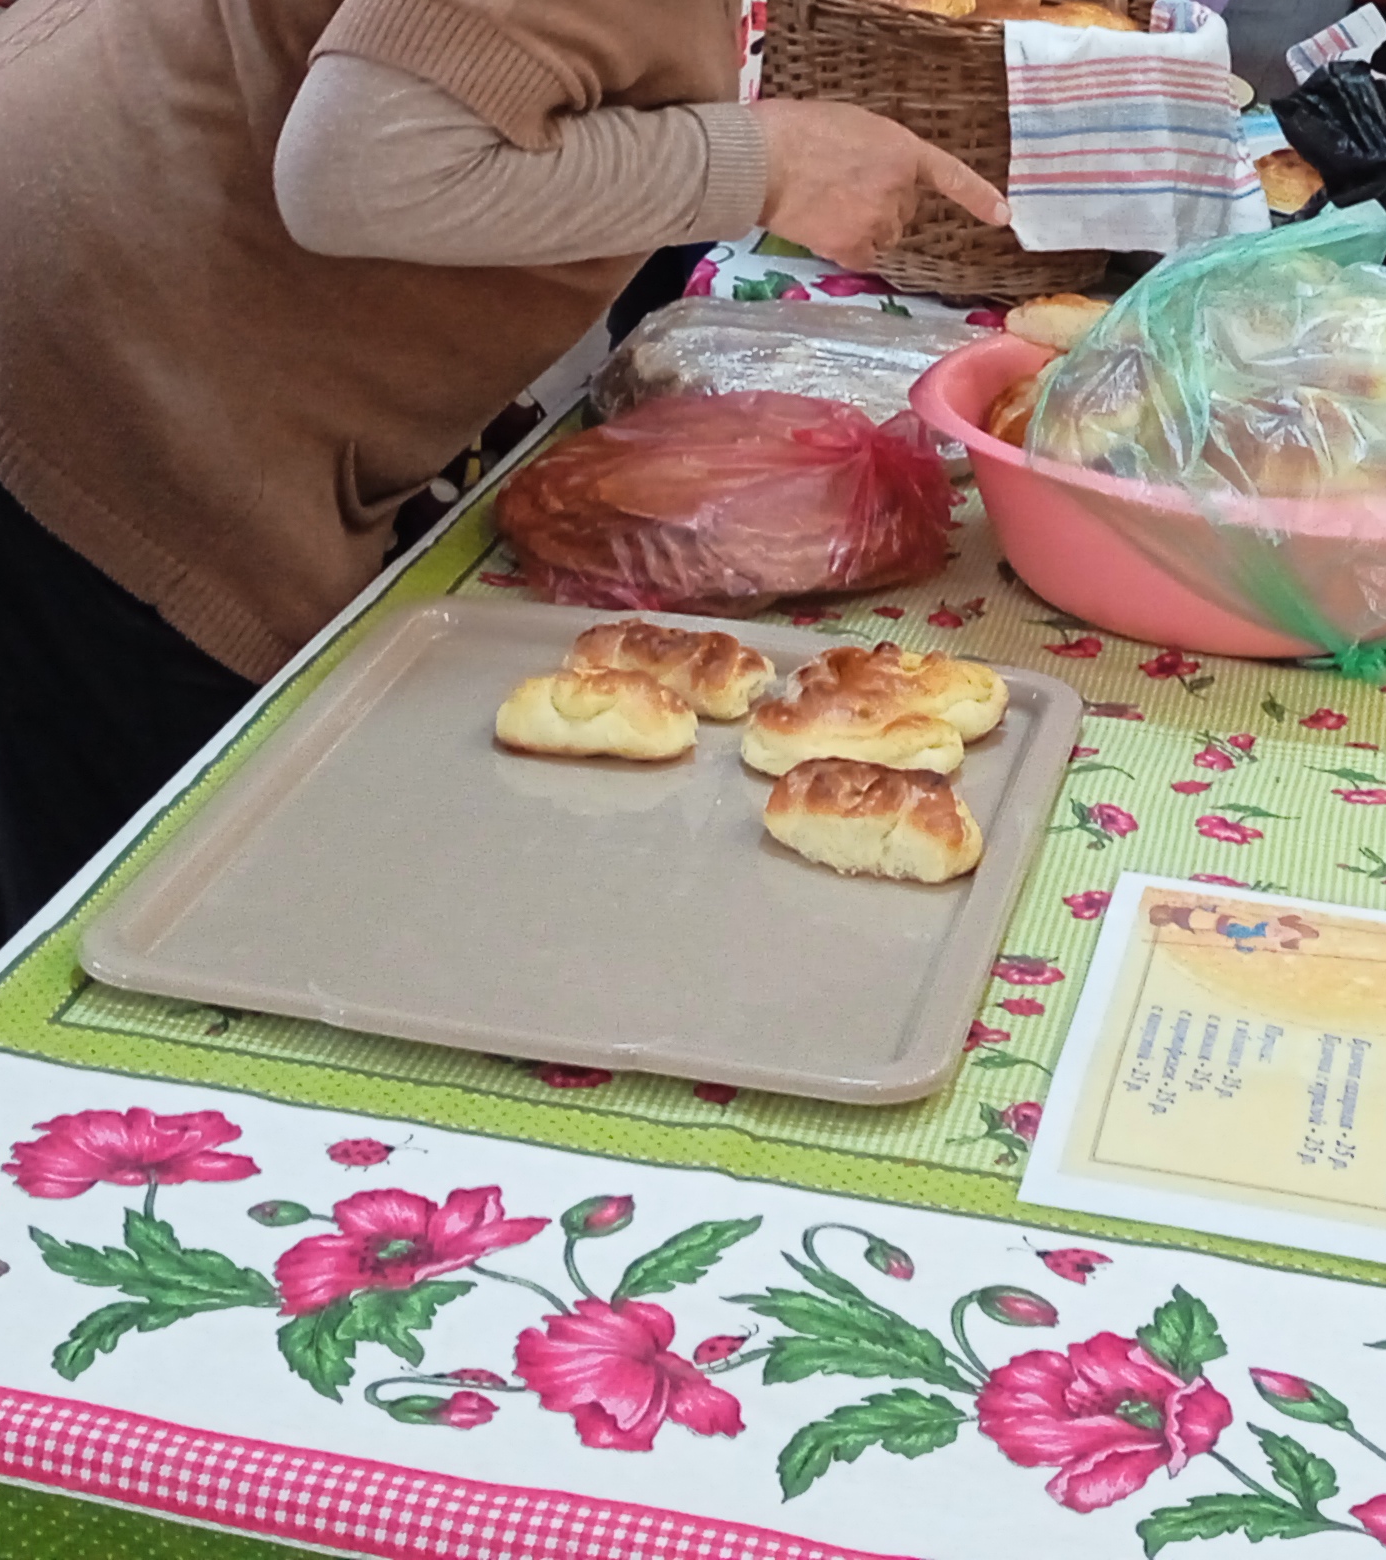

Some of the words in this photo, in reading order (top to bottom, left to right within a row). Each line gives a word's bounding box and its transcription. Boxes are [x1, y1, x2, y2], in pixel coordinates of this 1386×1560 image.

[1130, 1067, 1151, 1084] 25
[1191, 1068, 1213, 1084] 25
[1221, 1074, 1242, 1090] 25
[1155, 1087, 1177, 1105] 25
[1303, 1135, 1325, 1154] 25
[1334, 1139, 1357, 1160] 25
